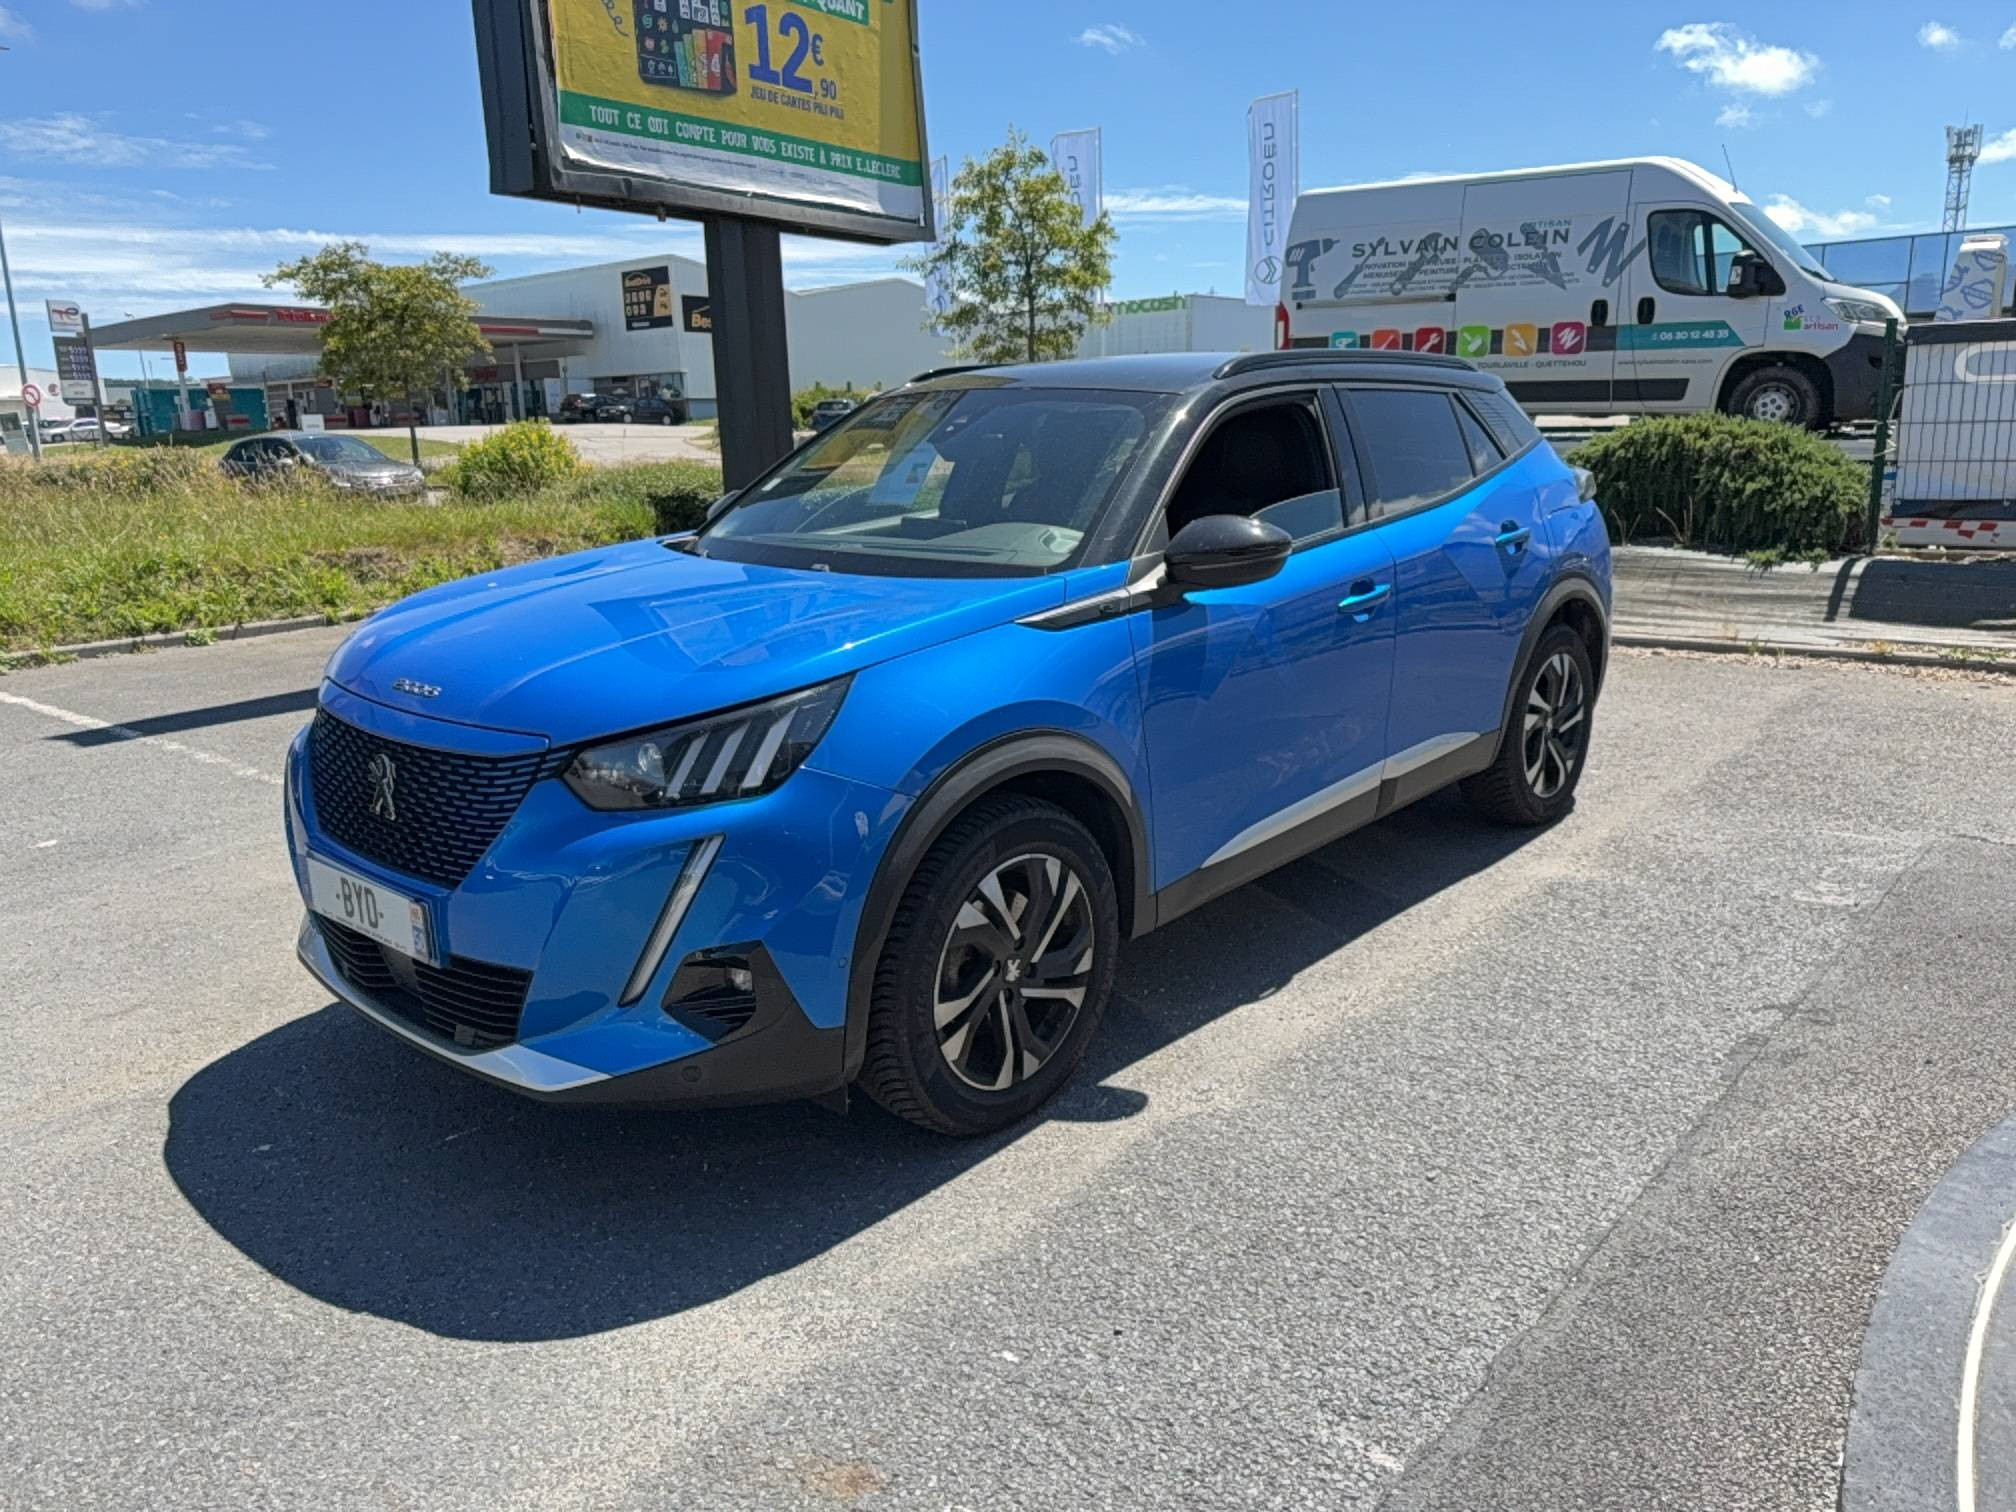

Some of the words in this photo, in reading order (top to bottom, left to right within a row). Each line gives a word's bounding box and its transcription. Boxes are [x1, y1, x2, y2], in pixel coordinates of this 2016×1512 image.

[744, 4, 813, 94] 12
[589, 105, 621, 126] TOUT
[626, 111, 642, 130] CE
[647, 115, 669, 135] QUI
[675, 120, 716, 143] COMPTE
[720, 129, 748, 148] POUR
[751, 135, 777, 154] VOUS
[780, 141, 815, 162] EXISTE
[819, 147, 827, 164] À
[829, 151, 853, 168] PRIX
[1352, 236, 1459, 258] SYLVAIN
[1469, 228, 1570, 249] COLEIN
